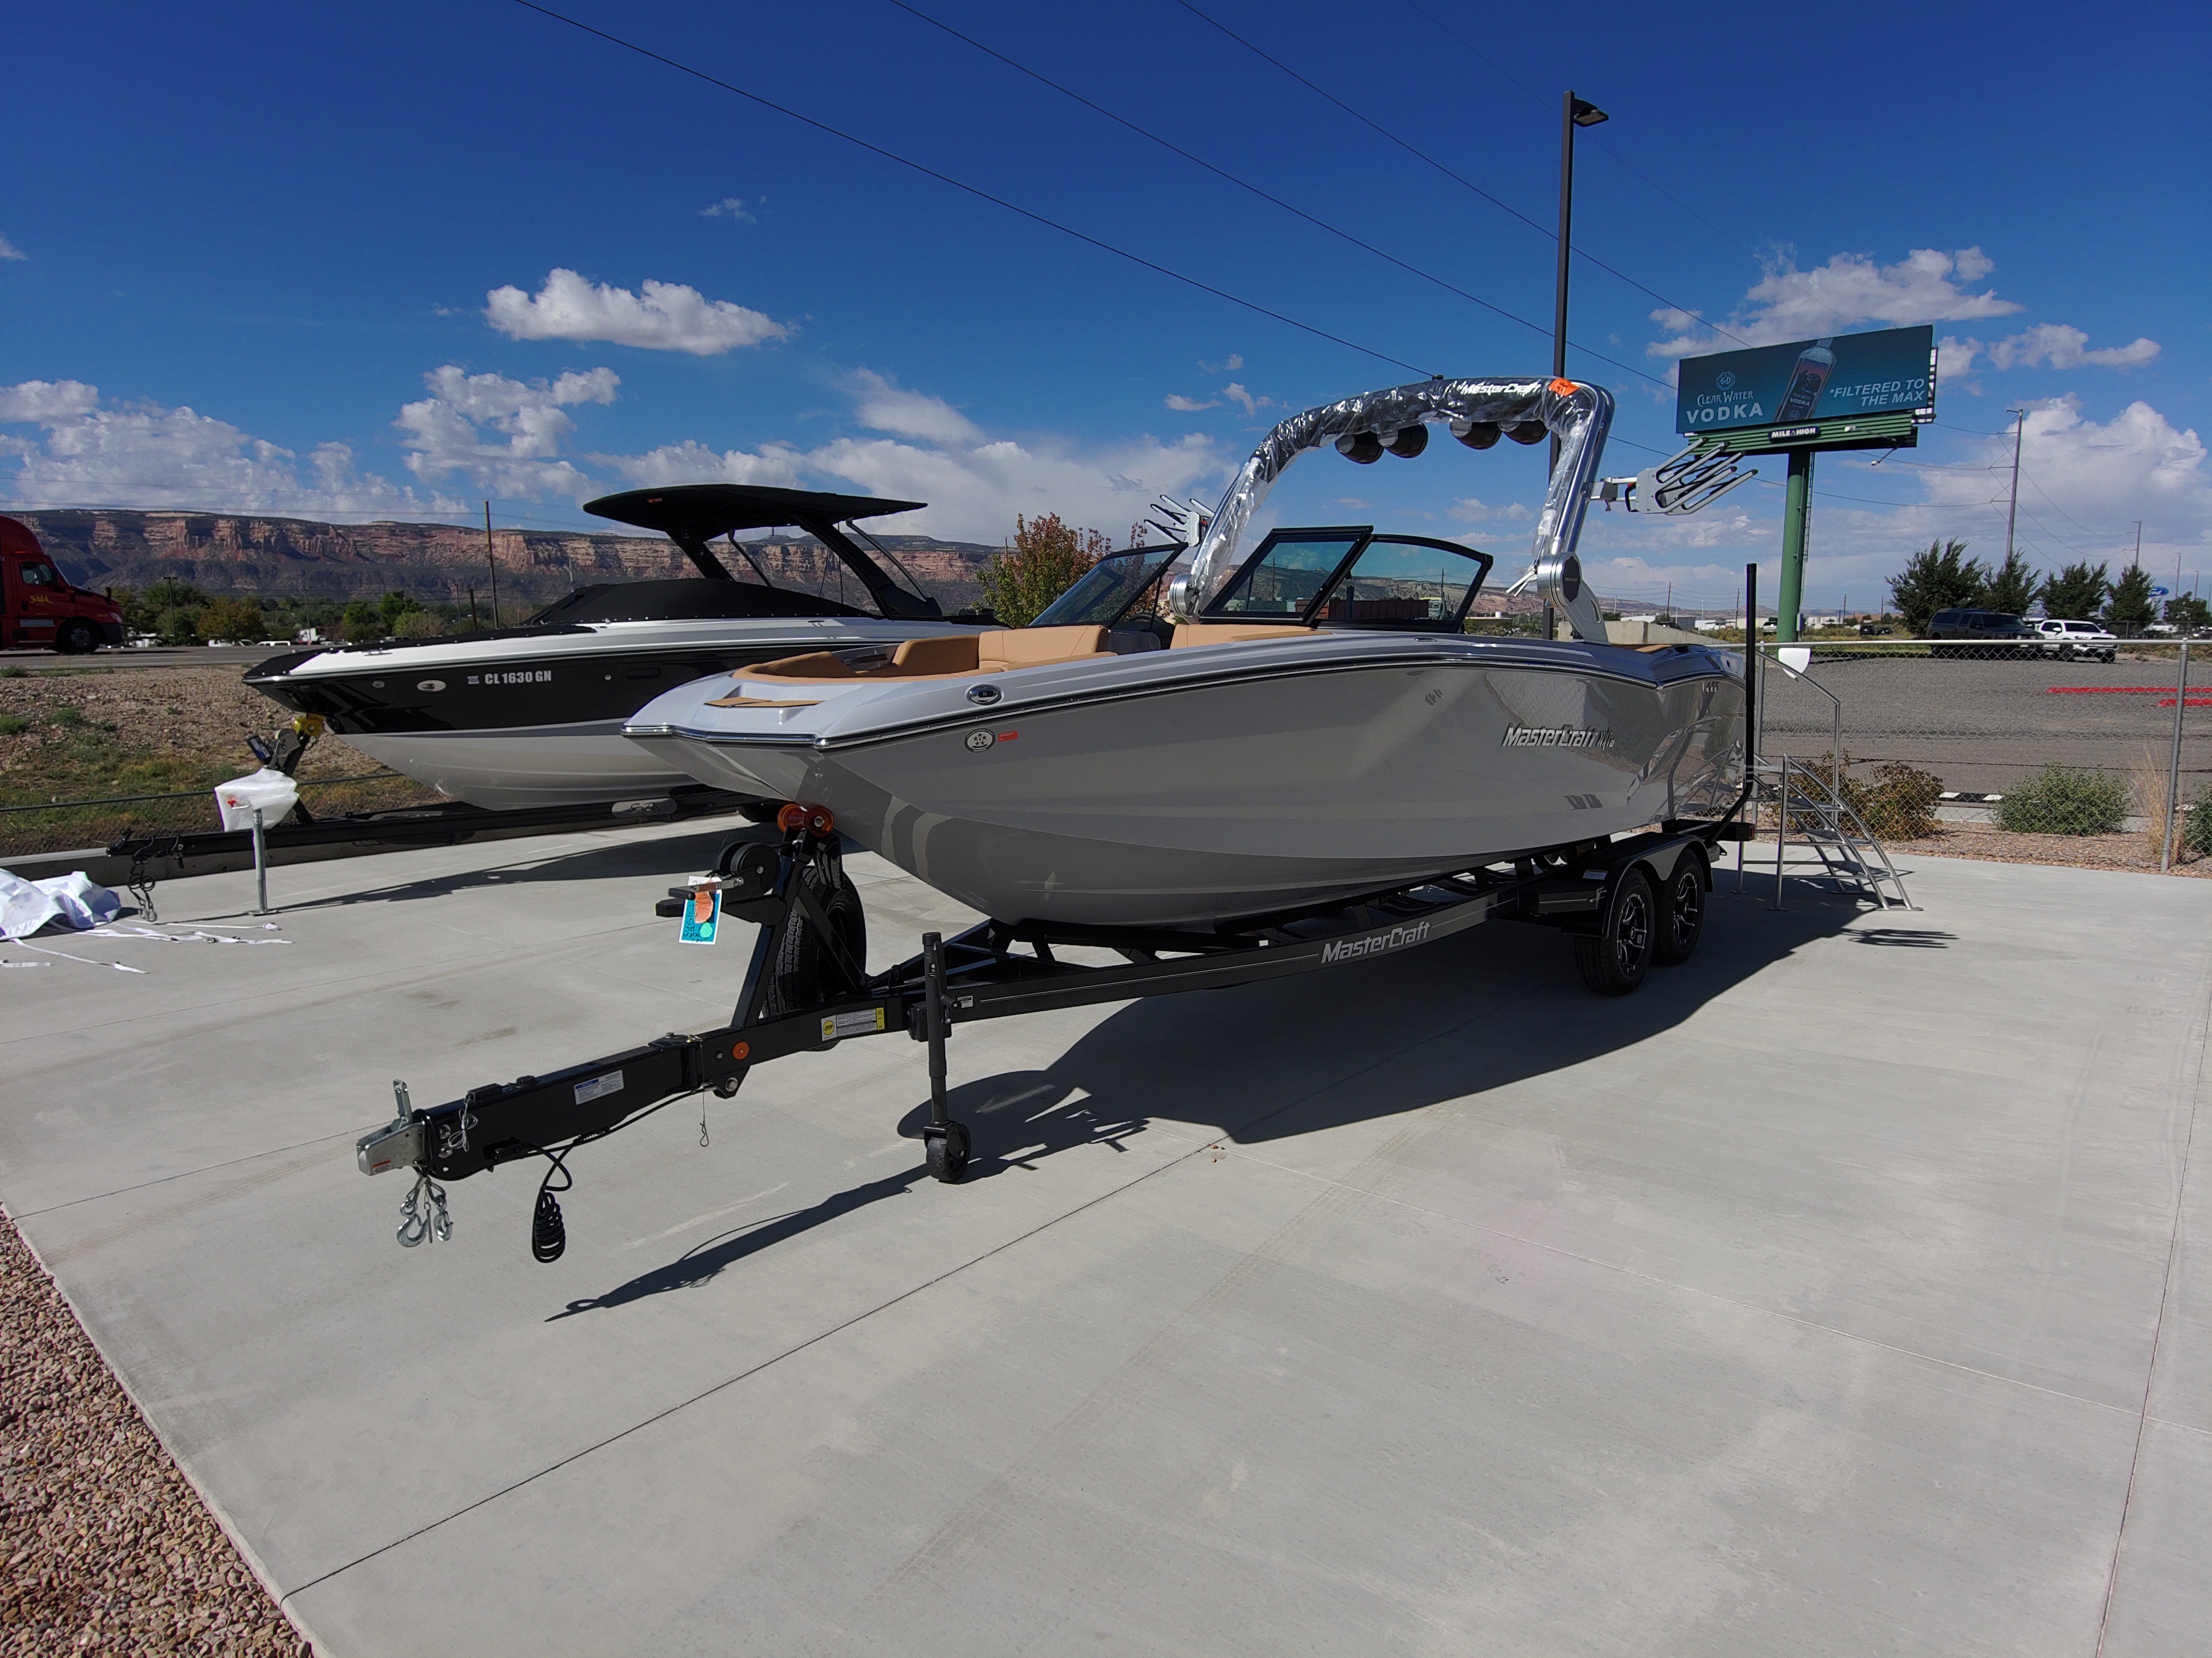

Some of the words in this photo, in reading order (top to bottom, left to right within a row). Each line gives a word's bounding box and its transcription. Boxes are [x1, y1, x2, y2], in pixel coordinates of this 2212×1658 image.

[1906, 378, 1925, 390] TO
[1697, 393, 1722, 407] CLEAR
[1723, 391, 1754, 403] WATER
[1790, 397, 1810, 406] VODKA
[1861, 394, 1889, 406] THE
[1891, 390, 1925, 404] MAX
[1686, 403, 1764, 424] VODKA
[1771, 430, 1791, 438] MILE
[1796, 427, 1816, 435] HIGH
[29, 594, 53, 604] SAIA
[484, 673, 500, 684] CL
[501, 671, 533, 684] 1630
[534, 670, 551, 682] GN
[1501, 724, 1598, 747] MasterCraft
[1320, 921, 1430, 964] MasterCraft
